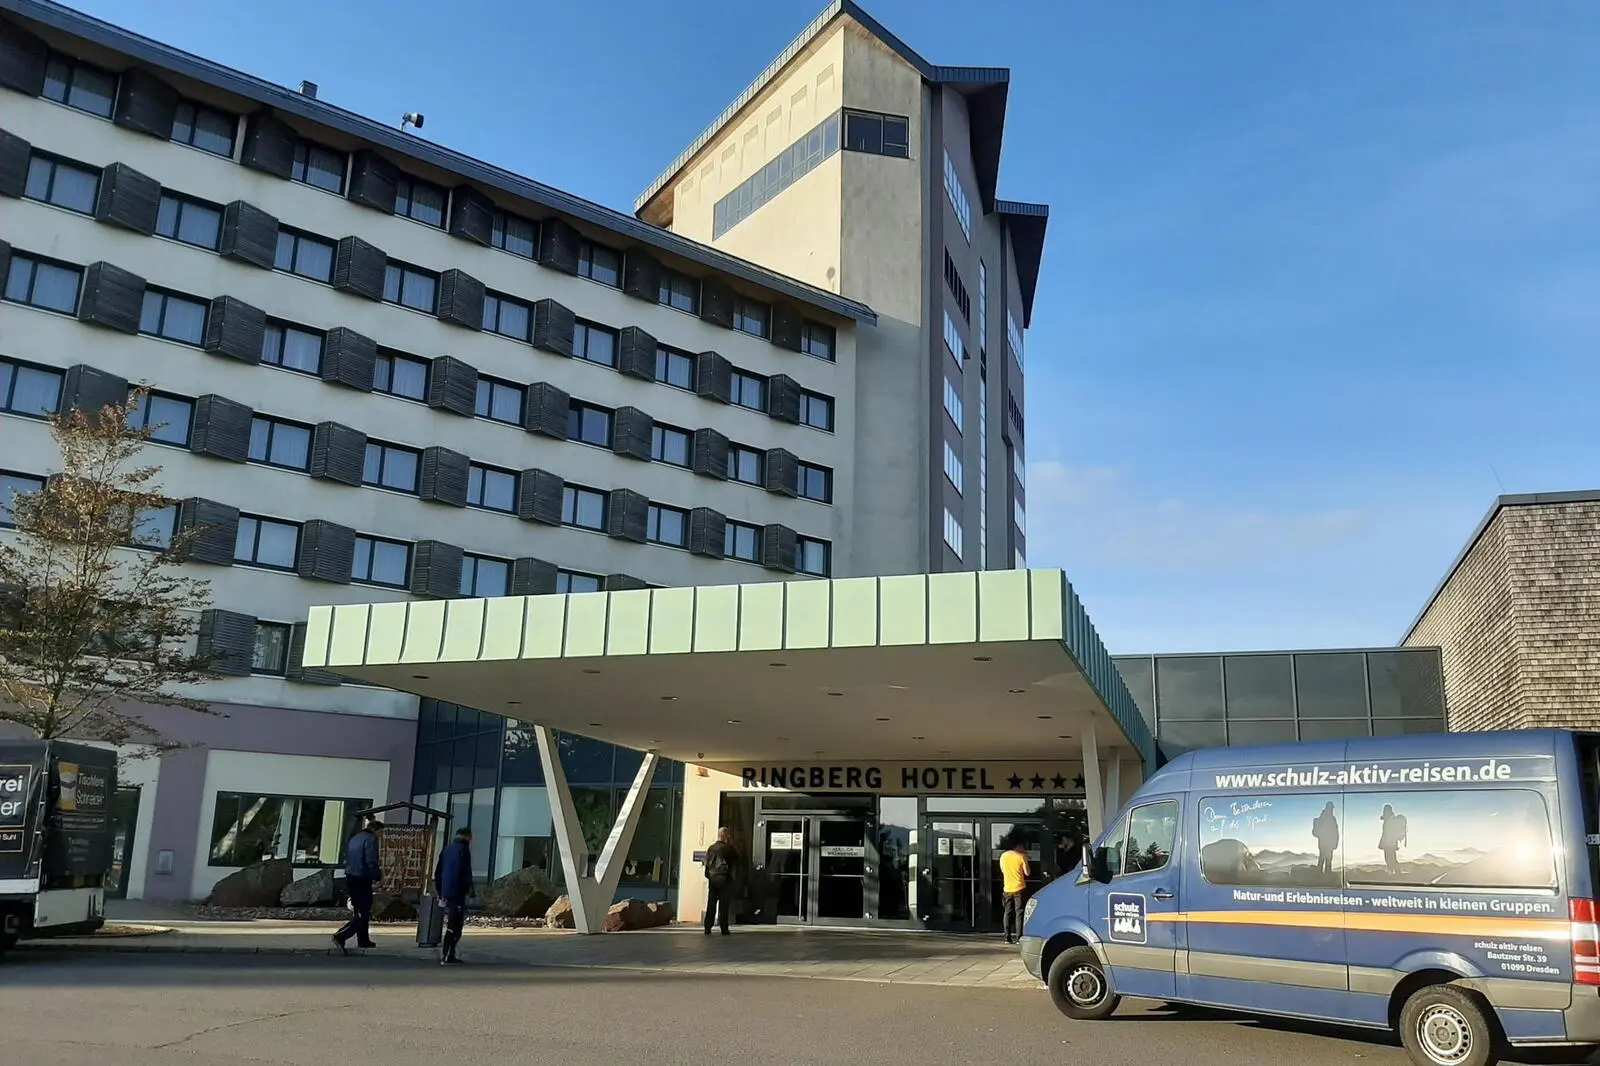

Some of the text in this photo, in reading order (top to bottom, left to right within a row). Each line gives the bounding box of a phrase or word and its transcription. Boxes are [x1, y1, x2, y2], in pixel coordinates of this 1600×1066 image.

[742, 767, 994, 790] RINGBERG HOTEL
[1215, 760, 1511, 788] www.schulz-aktiv-reisen.de
[1114, 902, 1140, 912] schulz
[1286, 891, 1363, 907] Erlebnisreisen
[1371, 895, 1423, 909] weltweit
[1425, 897, 1437, 909] in
[1439, 898, 1488, 911] kleinen
[1490, 899, 1555, 914] Gruppen.
[1474, 941, 1543, 953] schulz aktiv reisen
[1487, 951, 1547, 963] Bautzner Str. 39
[1501, 963, 1560, 975] 01099 Dresden
